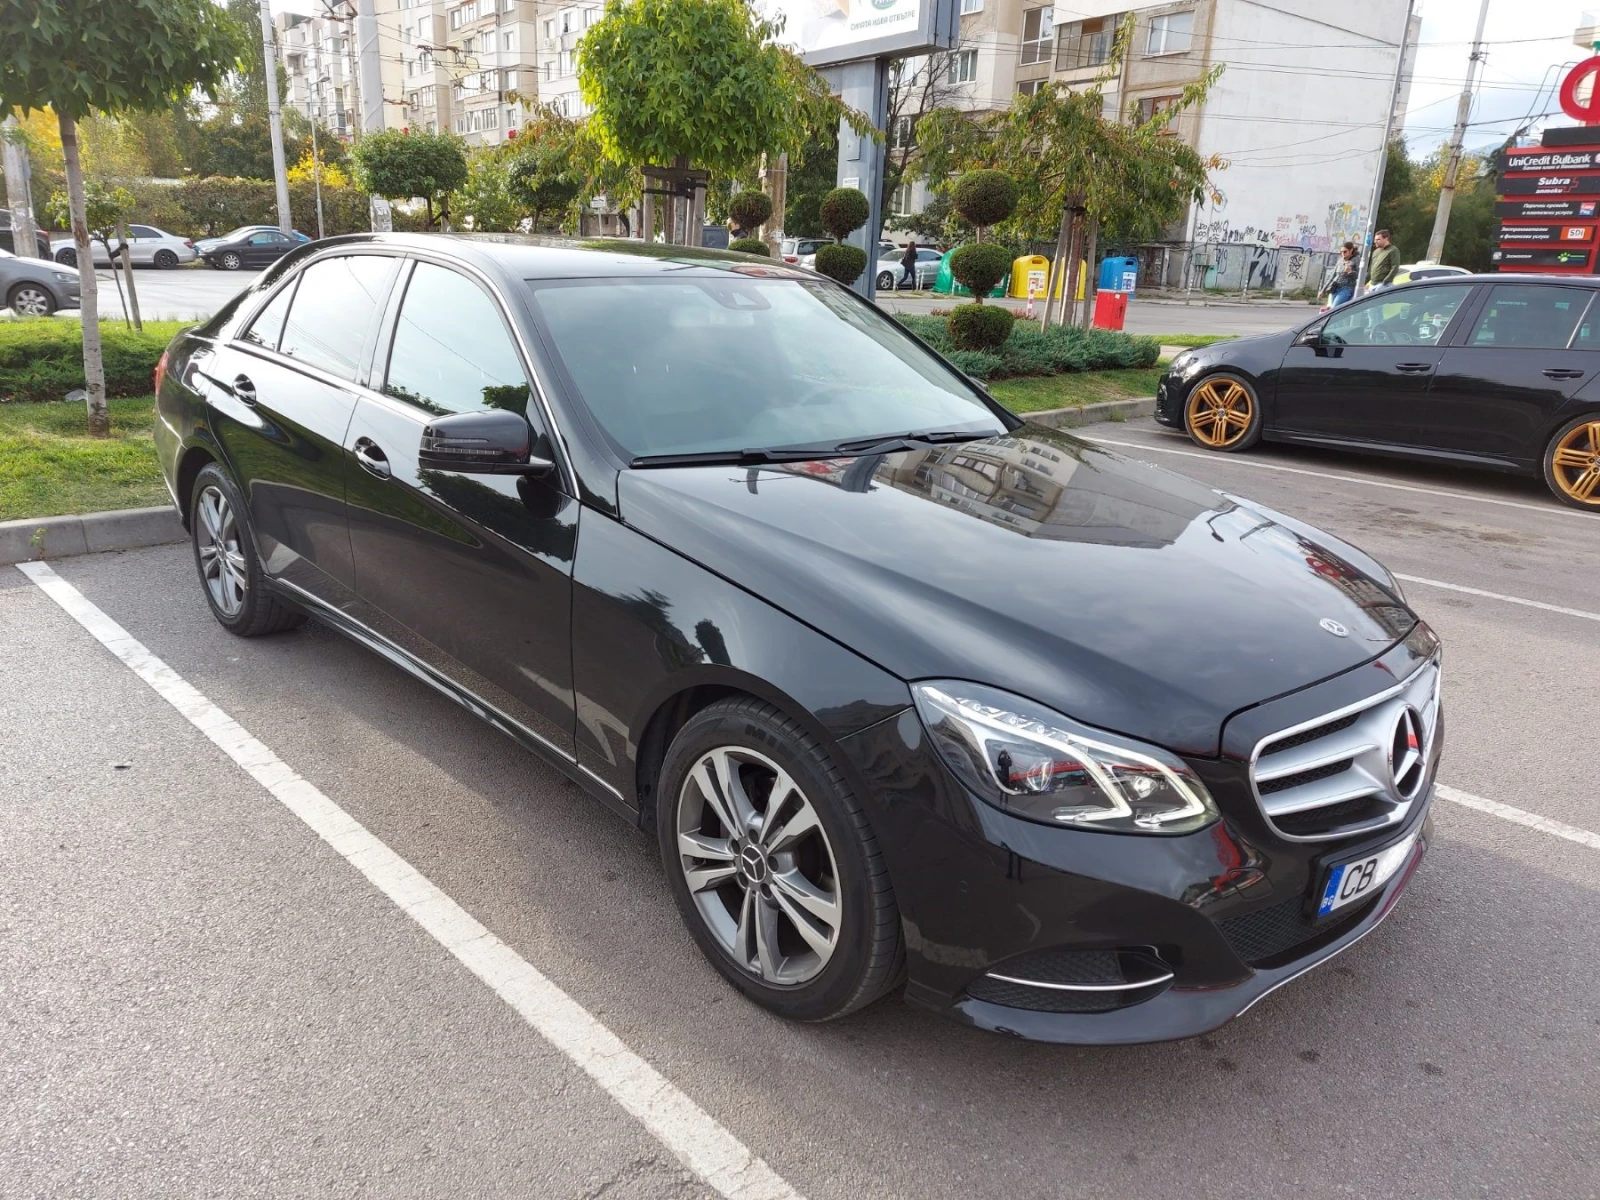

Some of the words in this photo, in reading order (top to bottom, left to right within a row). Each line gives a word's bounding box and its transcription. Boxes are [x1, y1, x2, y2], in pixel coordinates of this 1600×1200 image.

[1509, 155, 1551, 166] UniCredit
[1552, 154, 1591, 165] Bulbank
[1538, 177, 1571, 185] Subra
